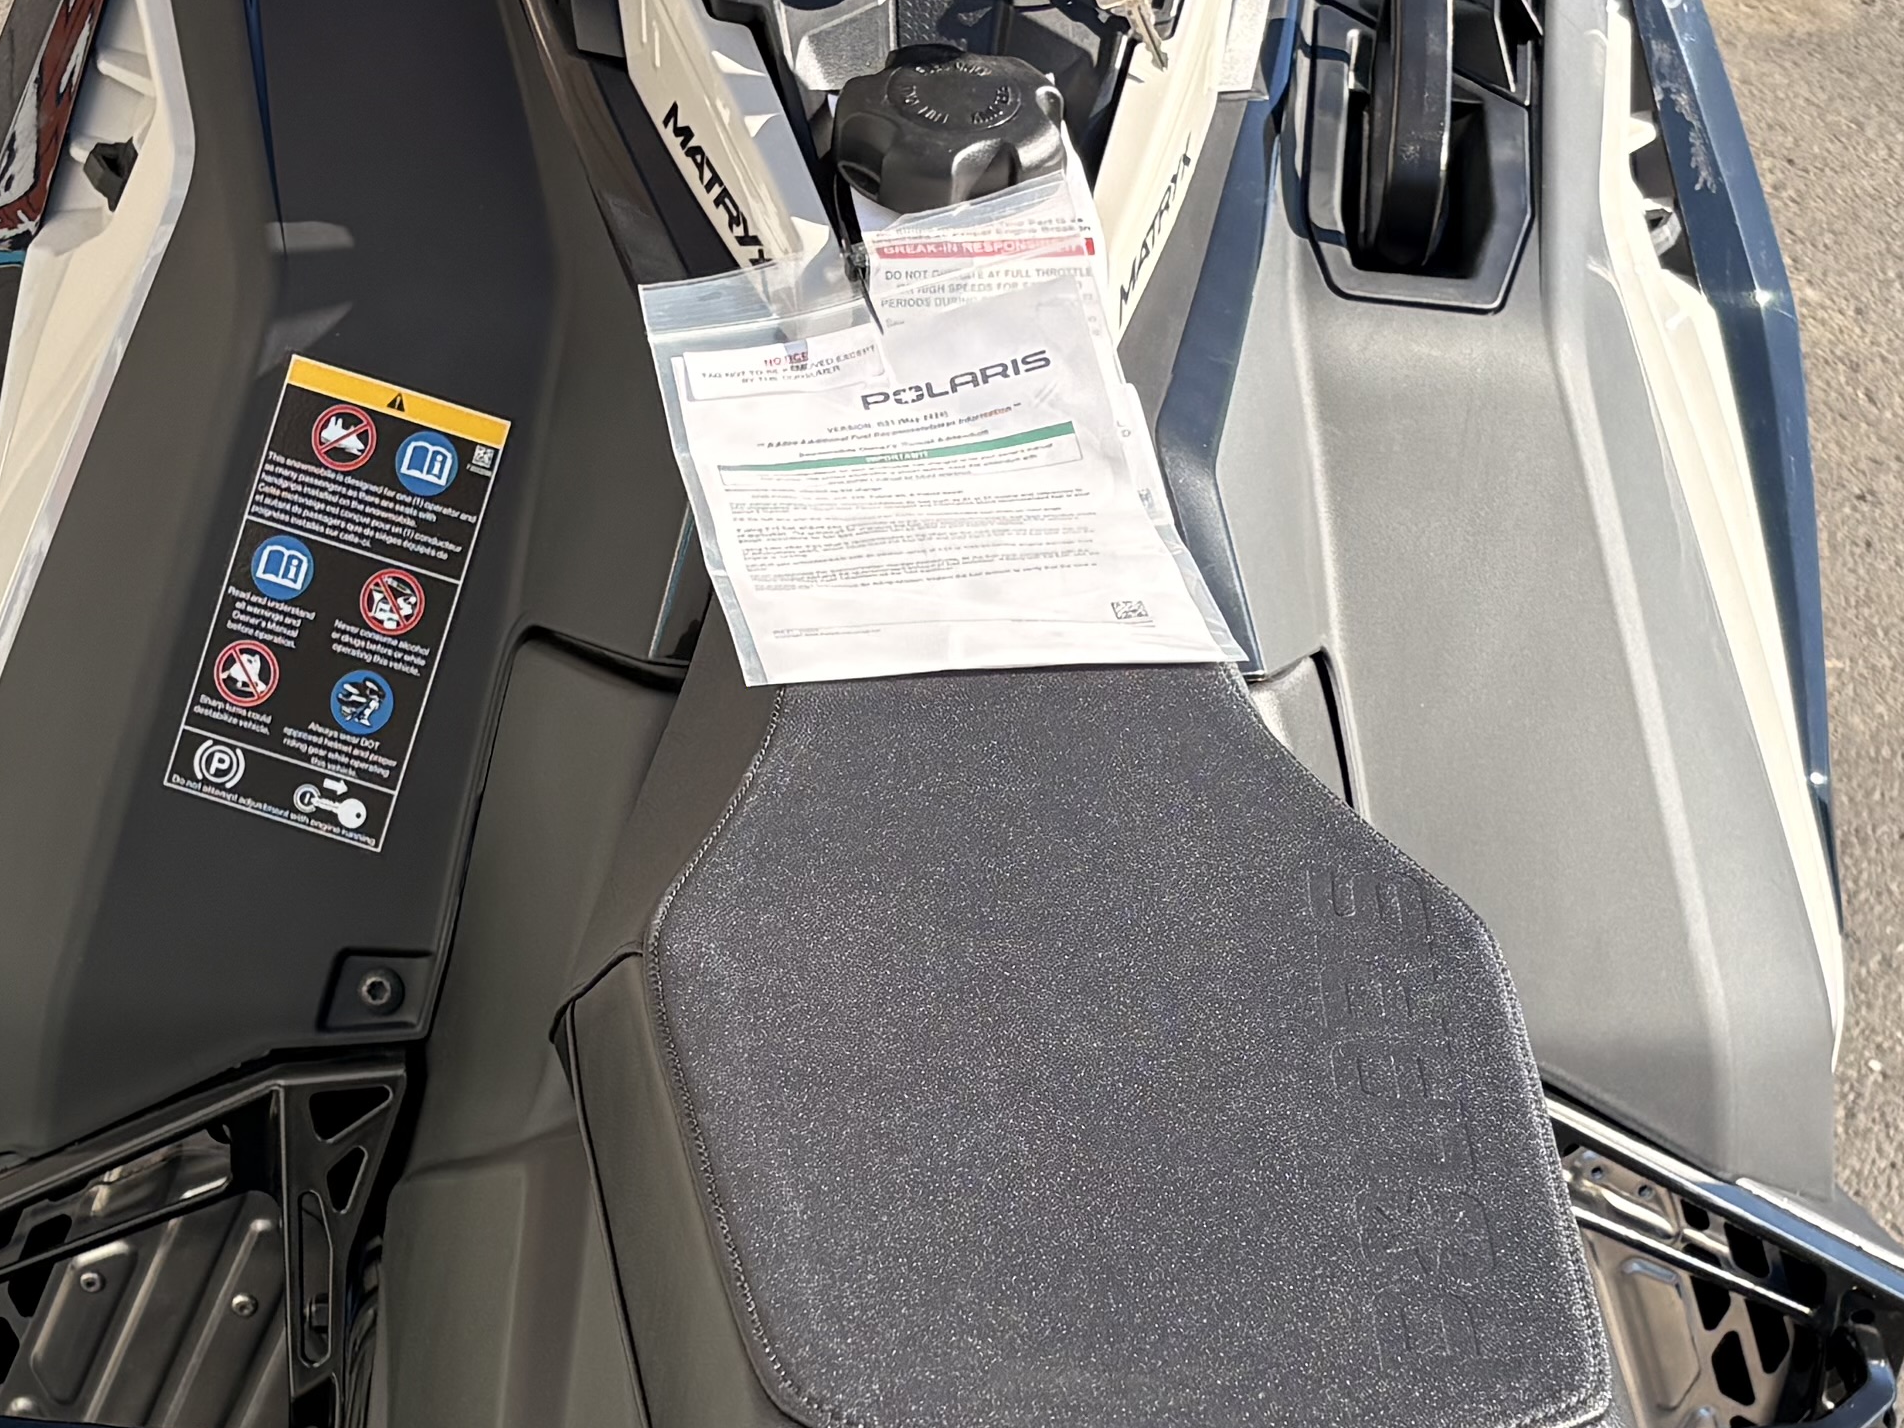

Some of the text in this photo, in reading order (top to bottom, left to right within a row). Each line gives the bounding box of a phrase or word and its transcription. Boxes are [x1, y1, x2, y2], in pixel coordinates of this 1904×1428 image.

[1119, 131, 1192, 330] MATRYX
[883, 242, 958, 254] BREAK-IN
[885, 270, 903, 281] DO
[905, 269, 929, 280] NOT
[1004, 269, 1032, 279] FULL
[1035, 267, 1093, 278] THROTTLE
[881, 297, 932, 308] PERIODS
[861, 349, 1052, 411] POLARIS
